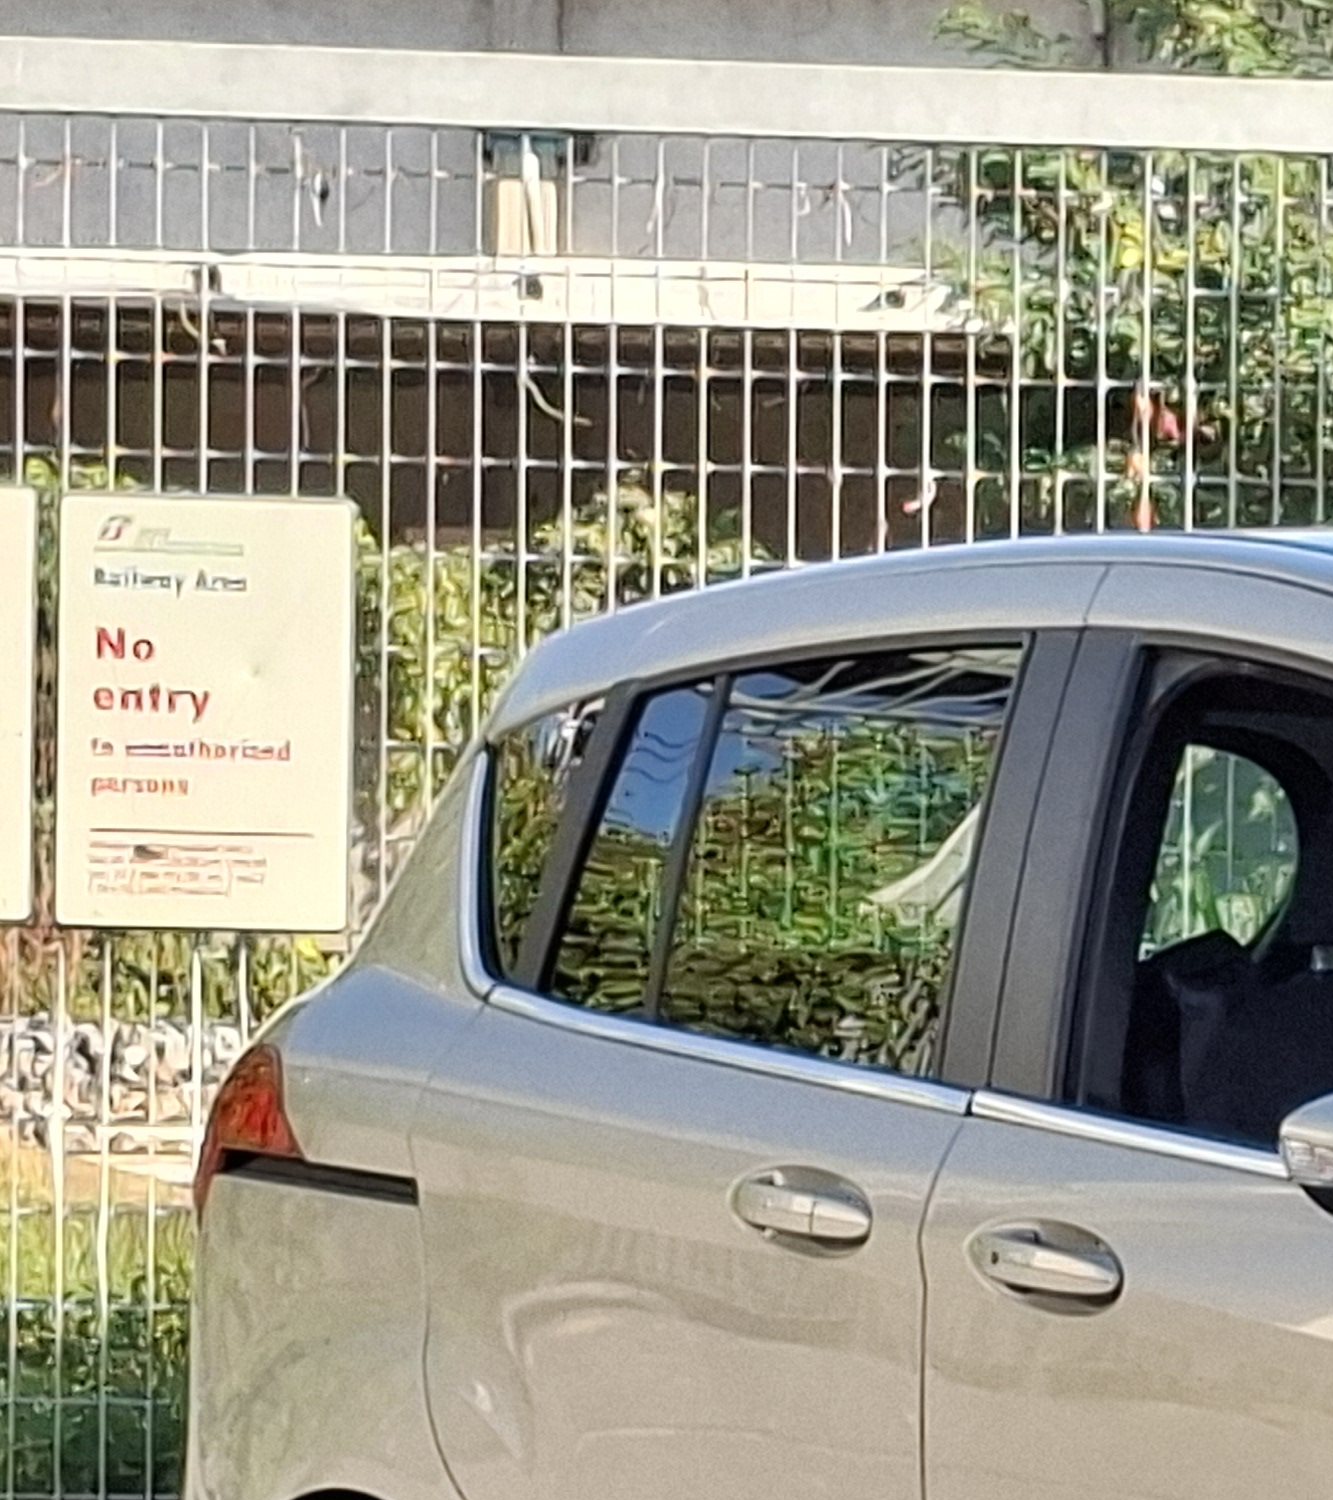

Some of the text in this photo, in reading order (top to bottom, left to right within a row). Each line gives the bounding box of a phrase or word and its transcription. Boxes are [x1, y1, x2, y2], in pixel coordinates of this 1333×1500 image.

[96, 626, 155, 661] No
[93, 683, 210, 724] entry
[125, 737, 291, 761] uthoried
